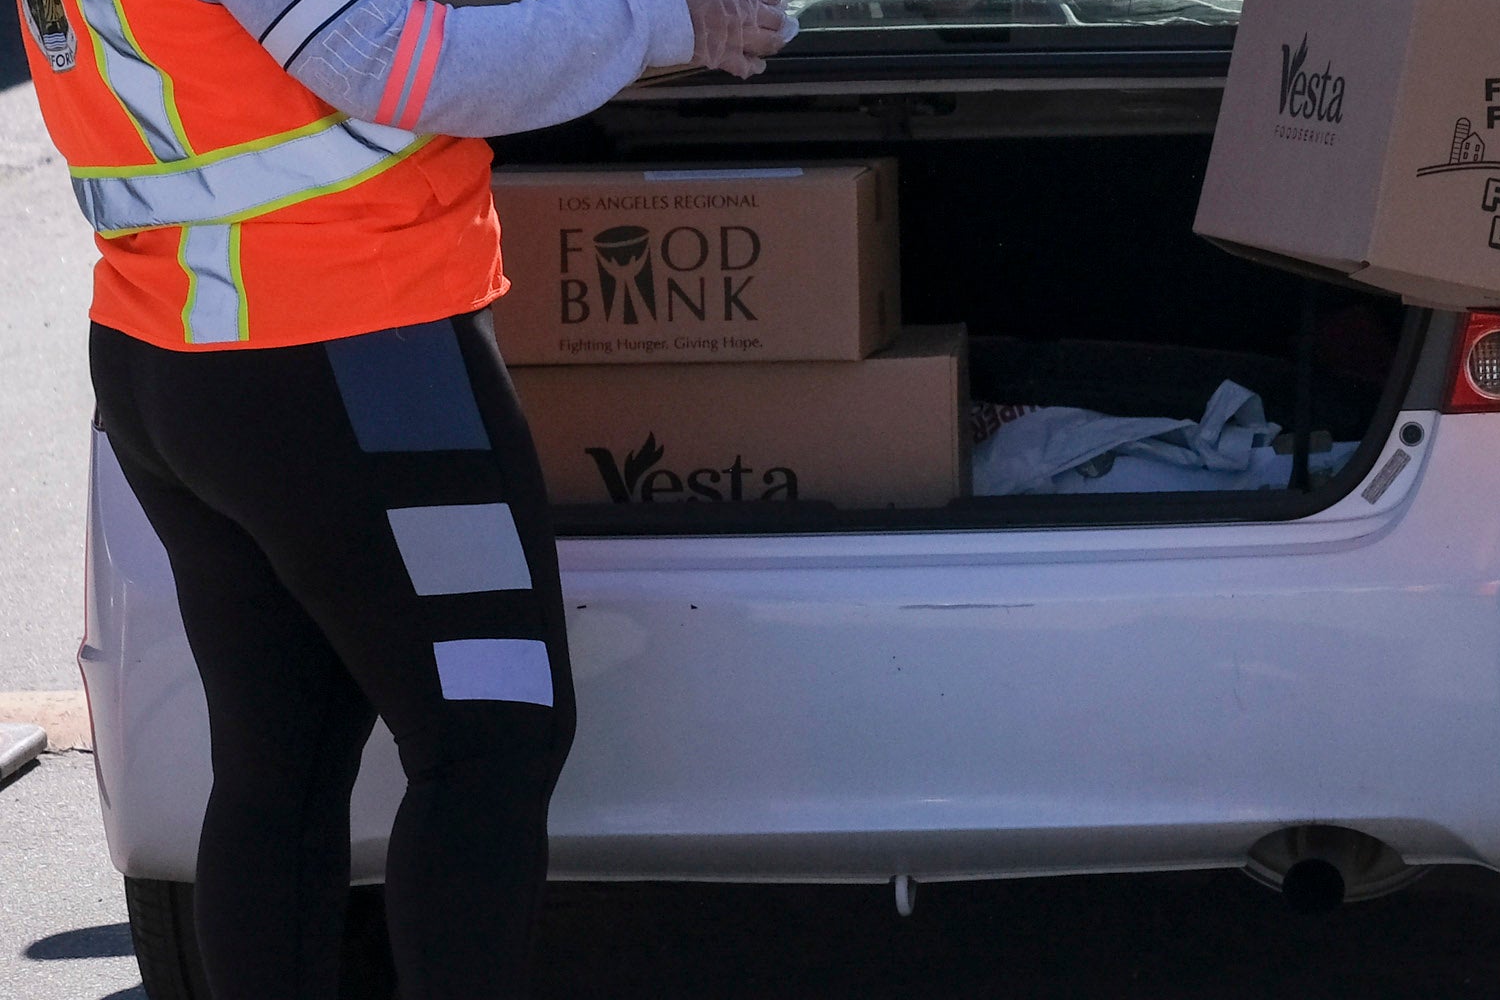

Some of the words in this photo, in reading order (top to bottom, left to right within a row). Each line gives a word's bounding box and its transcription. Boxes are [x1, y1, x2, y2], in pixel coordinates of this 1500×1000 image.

[1279, 31, 1345, 124] Vesta
[1274, 124, 1336, 146] FOODSERVICE
[559, 197, 591, 212] LOS
[595, 194, 669, 211] ANGELES
[673, 193, 760, 209] REGIONAL
[559, 338, 613, 356] Fighting
[617, 337, 668, 354] Hunger.
[673, 336, 719, 354] Giving
[722, 335, 763, 352] Hope.
[585, 431, 799, 501] Vesta
